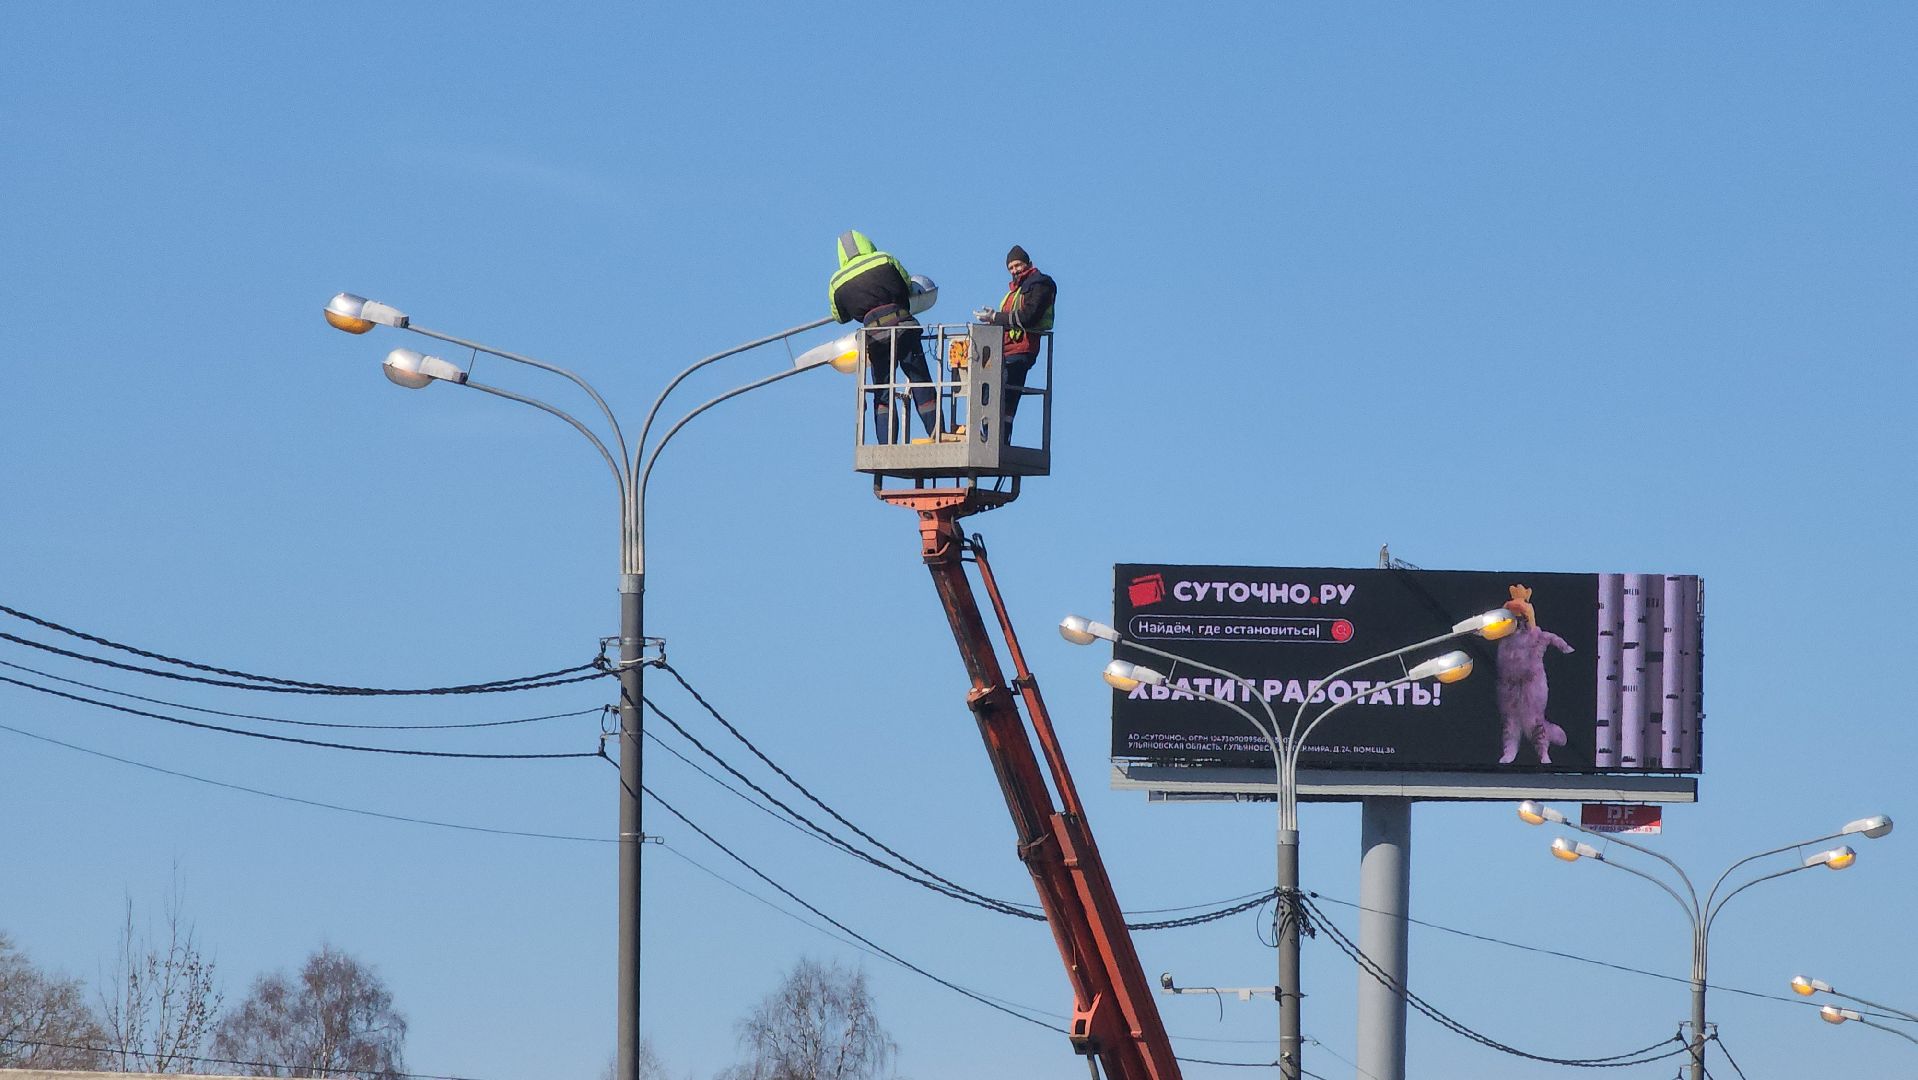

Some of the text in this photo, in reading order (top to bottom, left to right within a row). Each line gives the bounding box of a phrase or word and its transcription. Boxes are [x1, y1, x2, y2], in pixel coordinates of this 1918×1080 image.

[1173, 580, 1356, 606] СУТОЧНО.РУ
[1138, 620, 1194, 636] Найдём,
[1197, 624, 1221, 637] где
[1263, 678, 1442, 706] РАБОТАТЬ!
